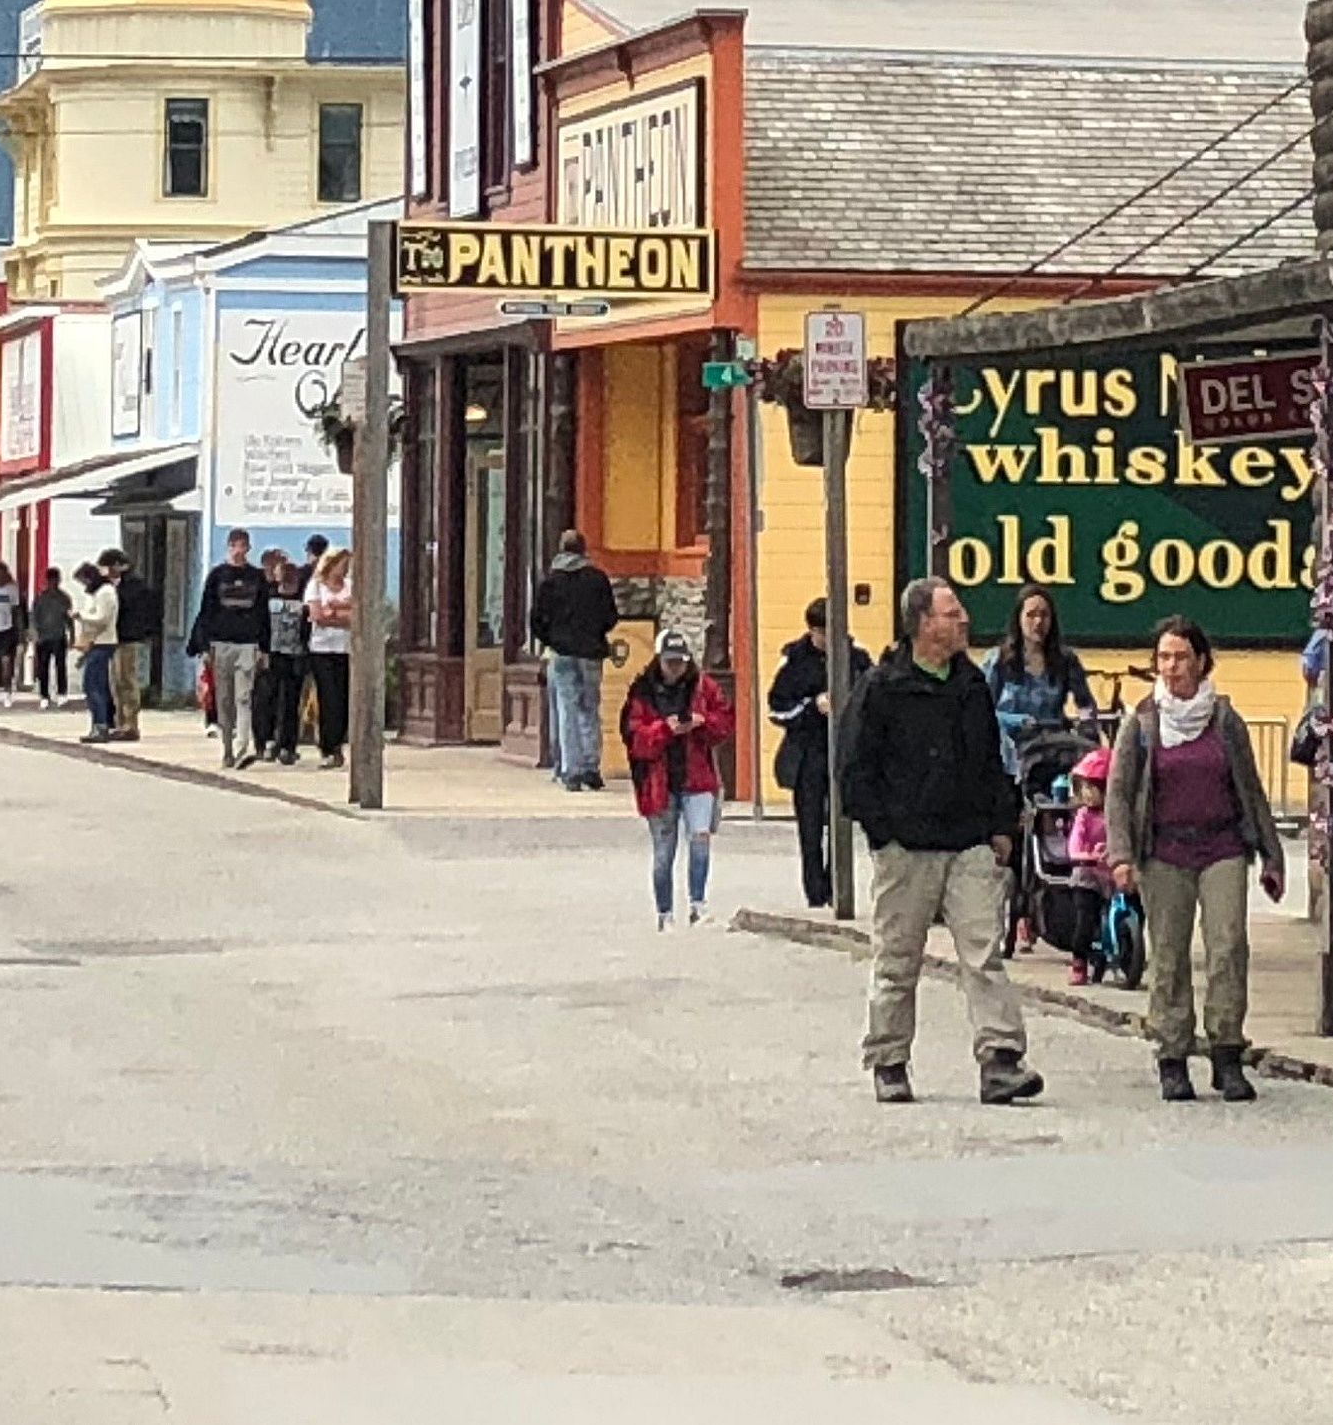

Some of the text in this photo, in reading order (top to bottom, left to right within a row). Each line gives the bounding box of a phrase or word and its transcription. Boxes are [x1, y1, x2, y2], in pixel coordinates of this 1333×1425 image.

[448, 232, 701, 290] PANTHEON
[1200, 374, 1278, 415] DEL
[966, 427, 1318, 501] whiskey
[947, 515, 1076, 587] old
